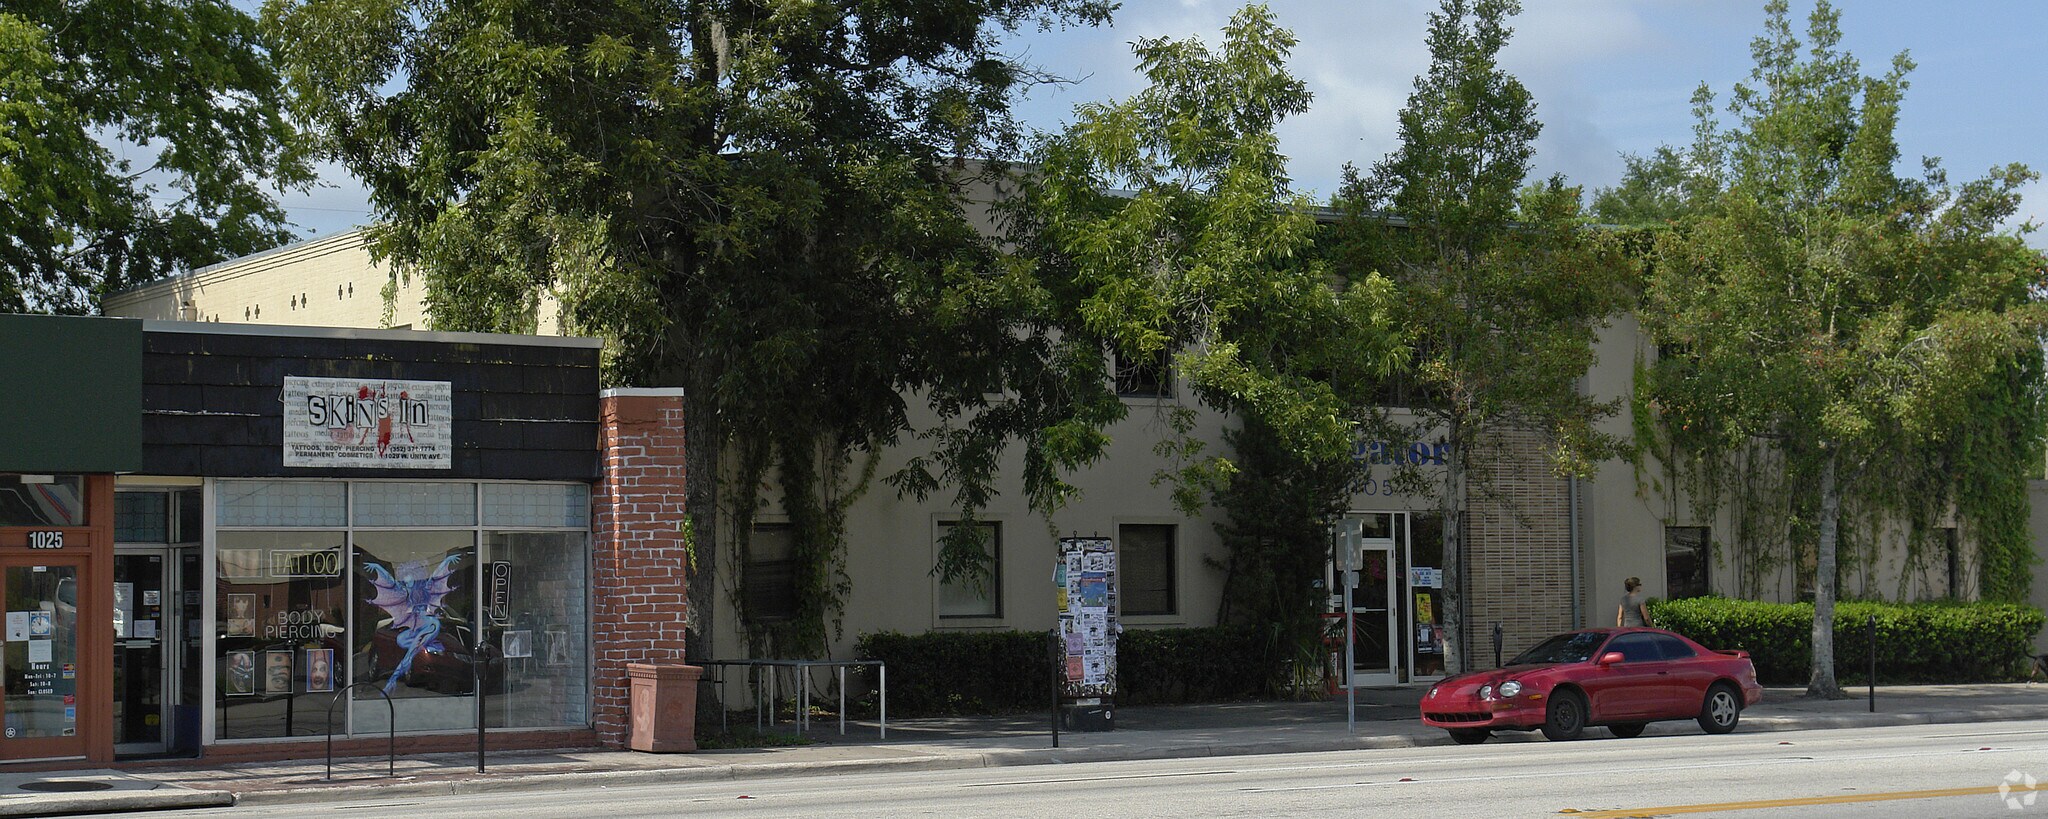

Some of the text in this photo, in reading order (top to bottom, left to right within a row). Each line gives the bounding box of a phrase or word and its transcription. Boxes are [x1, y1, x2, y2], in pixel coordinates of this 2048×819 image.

[291, 444, 322, 452] TATTOOS,
[29, 530, 64, 549] 1025
[272, 552, 338, 575] TATTOO
[494, 564, 508, 617] OPEN
[277, 610, 324, 625] BODY
[265, 624, 337, 639] PIERCING
[31, 662, 50, 670] Hours
